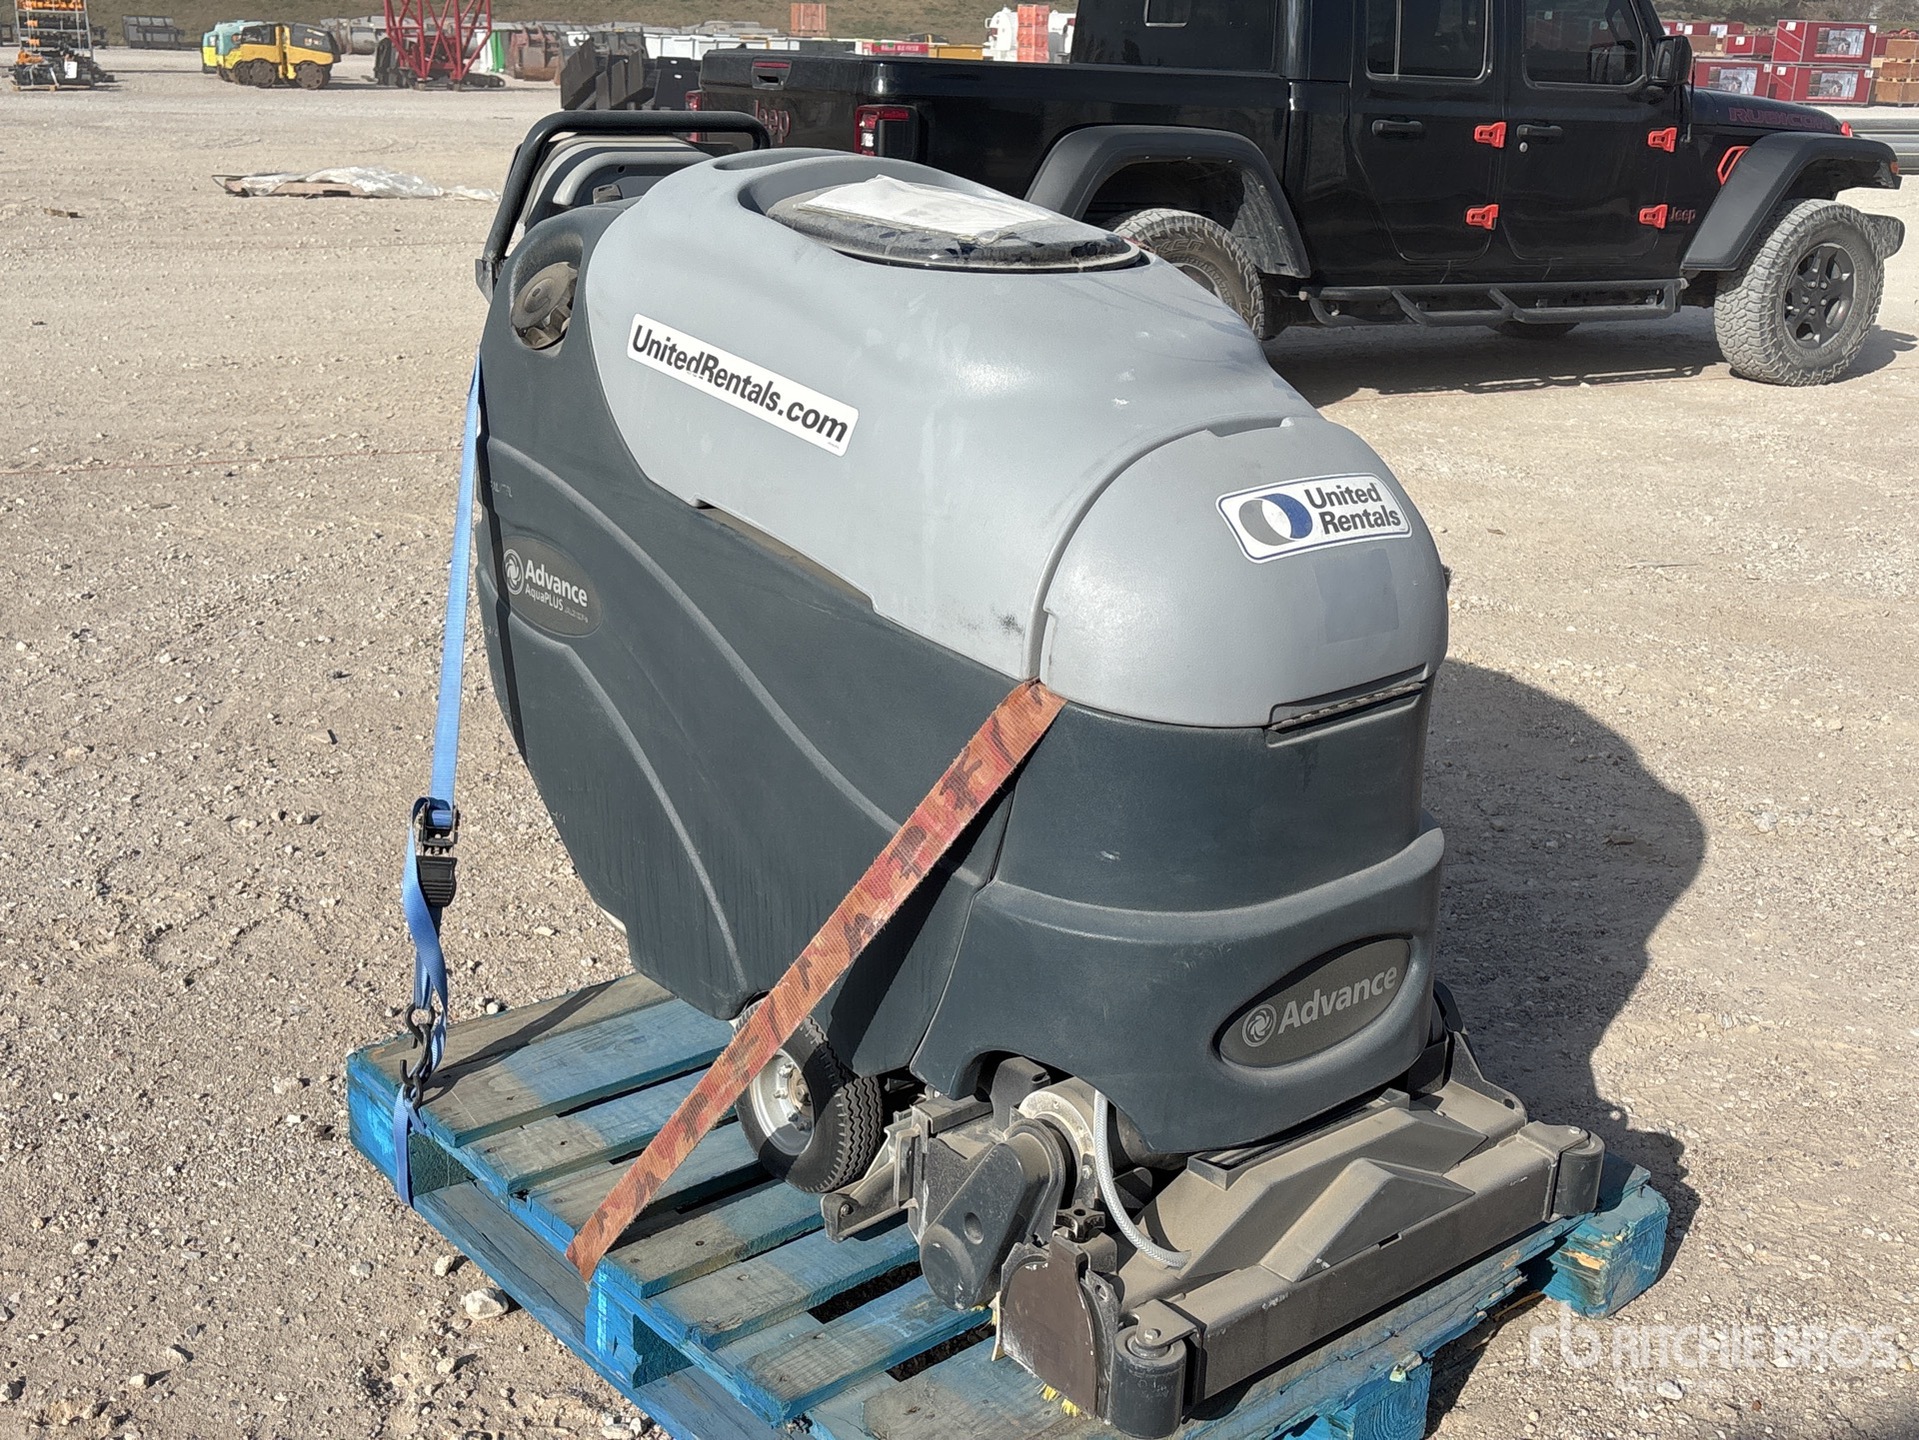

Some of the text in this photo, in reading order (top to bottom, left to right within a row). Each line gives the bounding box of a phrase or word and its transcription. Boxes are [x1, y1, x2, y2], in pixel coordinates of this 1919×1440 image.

[1728, 107, 1833, 131] RUBICON
[1668, 206, 1697, 224] Jeep
[632, 324, 849, 443] UnitedRentals.com
[1304, 482, 1382, 510] United
[1318, 505, 1402, 535] Rentals
[524, 583, 564, 612] AquaPLUS
[525, 559, 588, 608] Advance
[1277, 966, 1398, 1035] Advance
